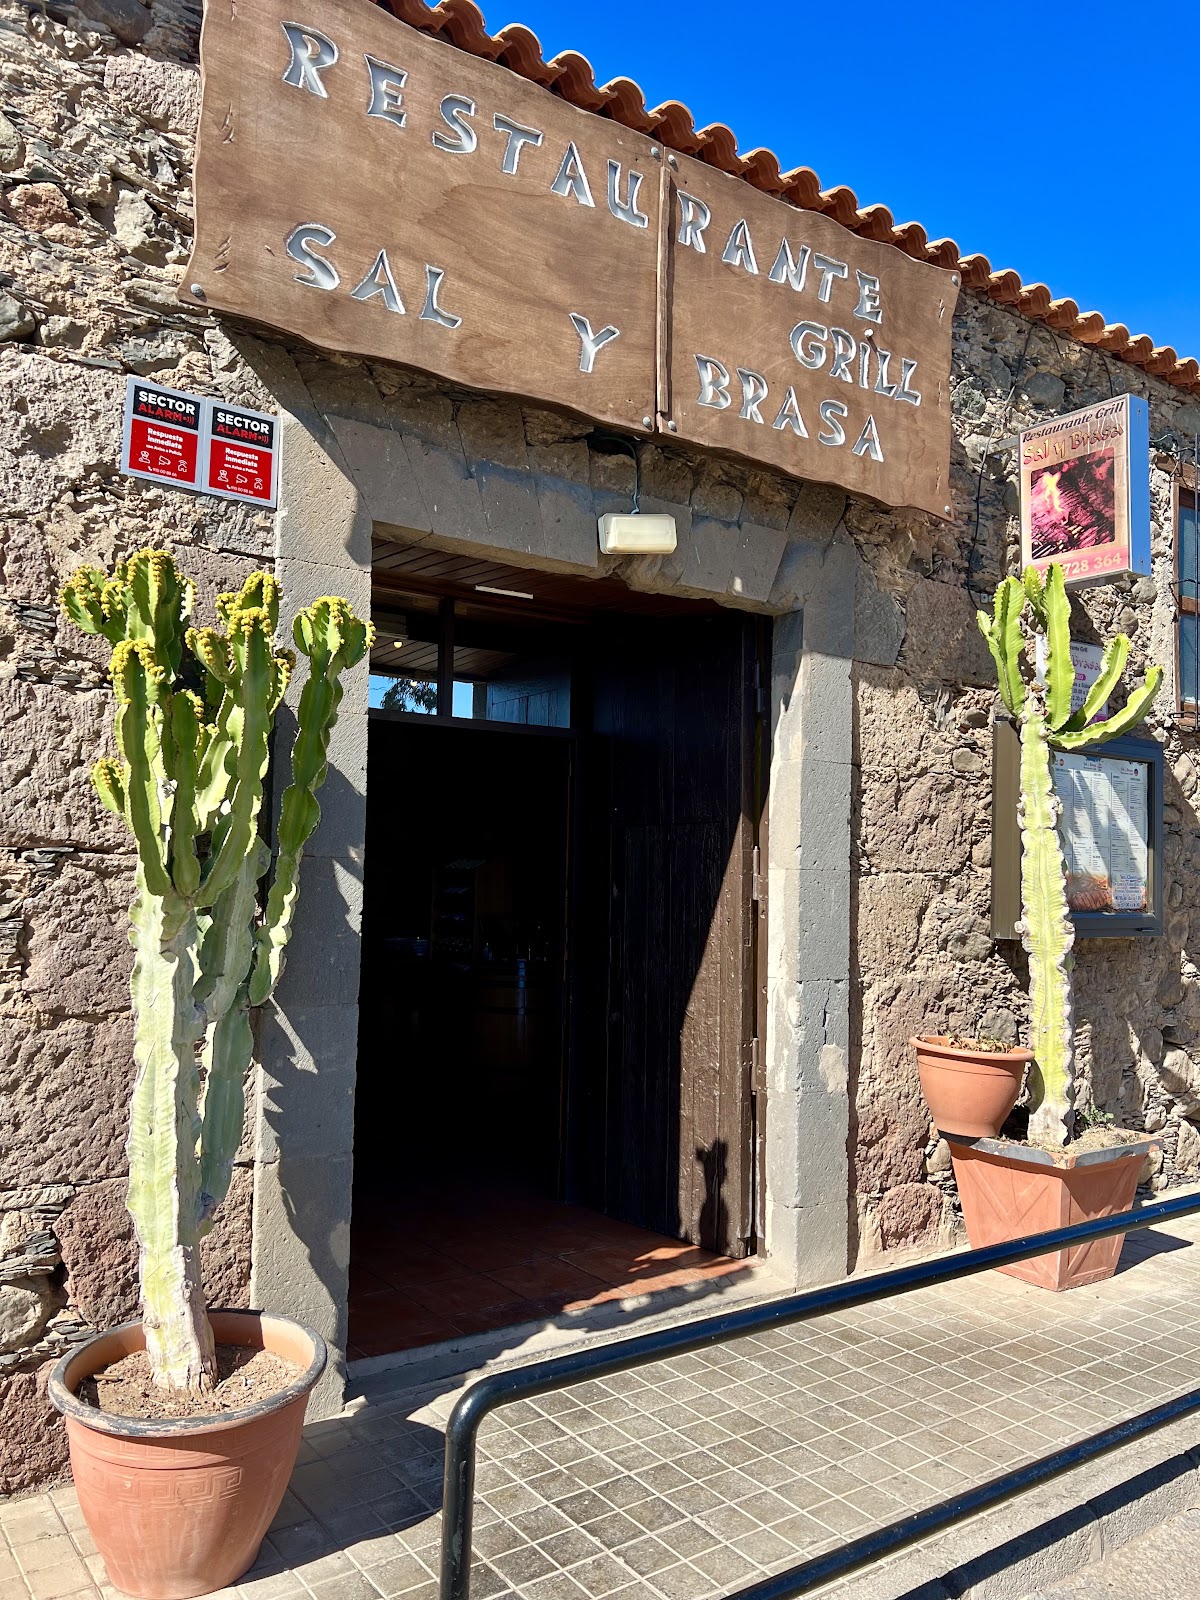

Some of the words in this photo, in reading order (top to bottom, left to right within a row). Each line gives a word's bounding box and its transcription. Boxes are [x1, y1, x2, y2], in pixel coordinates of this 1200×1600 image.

[285, 222, 463, 329] SAL
[568, 312, 621, 373] Y
[693, 353, 885, 463] BRASA
[138, 391, 196, 415] SECTOR
[138, 403, 183, 421] ALARM
[216, 412, 270, 434] SECTOR
[216, 423, 258, 440] ALARM
[1022, 413, 1093, 443] Restaurante
[1095, 401, 1125, 419] Grill
[147, 427, 183, 442] Respuesta
[1023, 438, 1050, 465] Sal
[1069, 423, 1124, 450] Brasa
[225, 447, 259, 461] Respuesta
[1063, 560, 1090, 576] 728
[1093, 552, 1122, 569] 364
